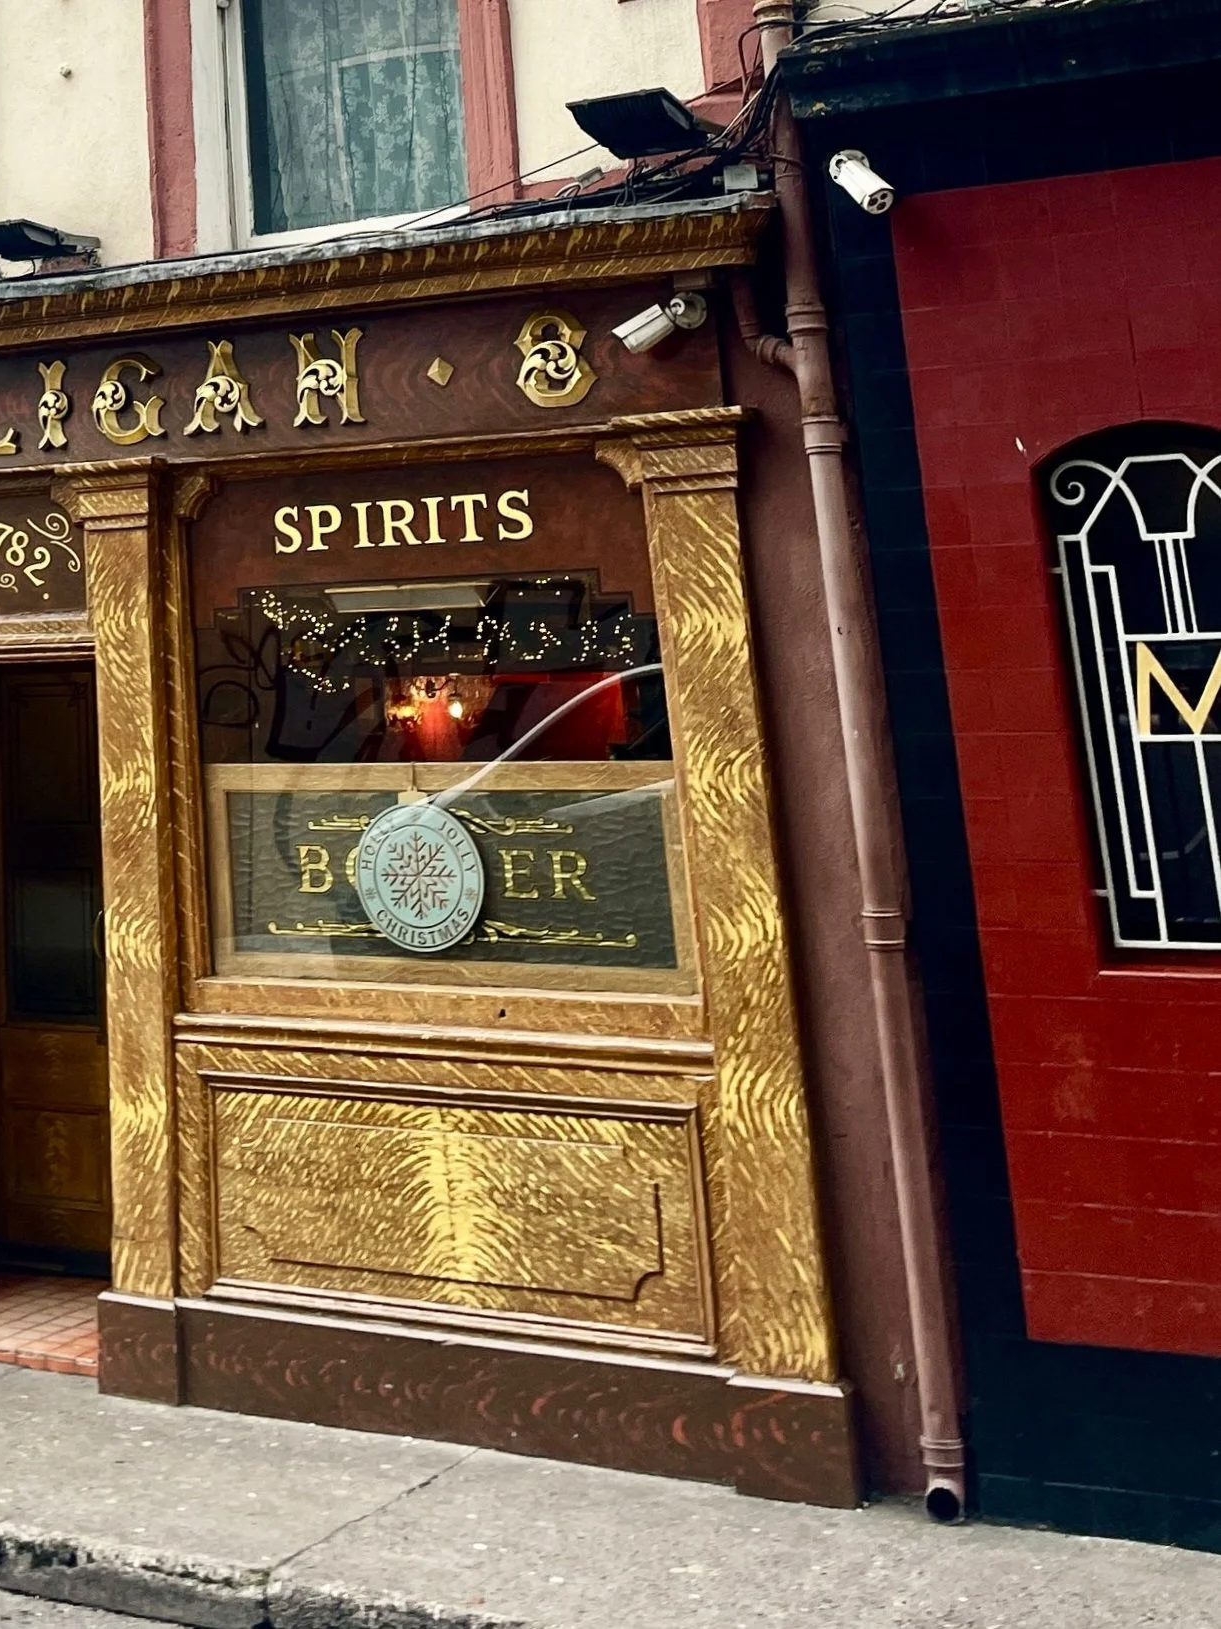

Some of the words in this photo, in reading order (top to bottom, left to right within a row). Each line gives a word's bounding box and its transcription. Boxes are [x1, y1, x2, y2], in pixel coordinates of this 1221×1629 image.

[516, 309, 599, 408] 8
[274, 489, 534, 554] SPIRITS
[295, 844, 598, 902] BER
[437, 820, 478, 873] JOLLY
[376, 907, 470, 946] CHRISTMAS
